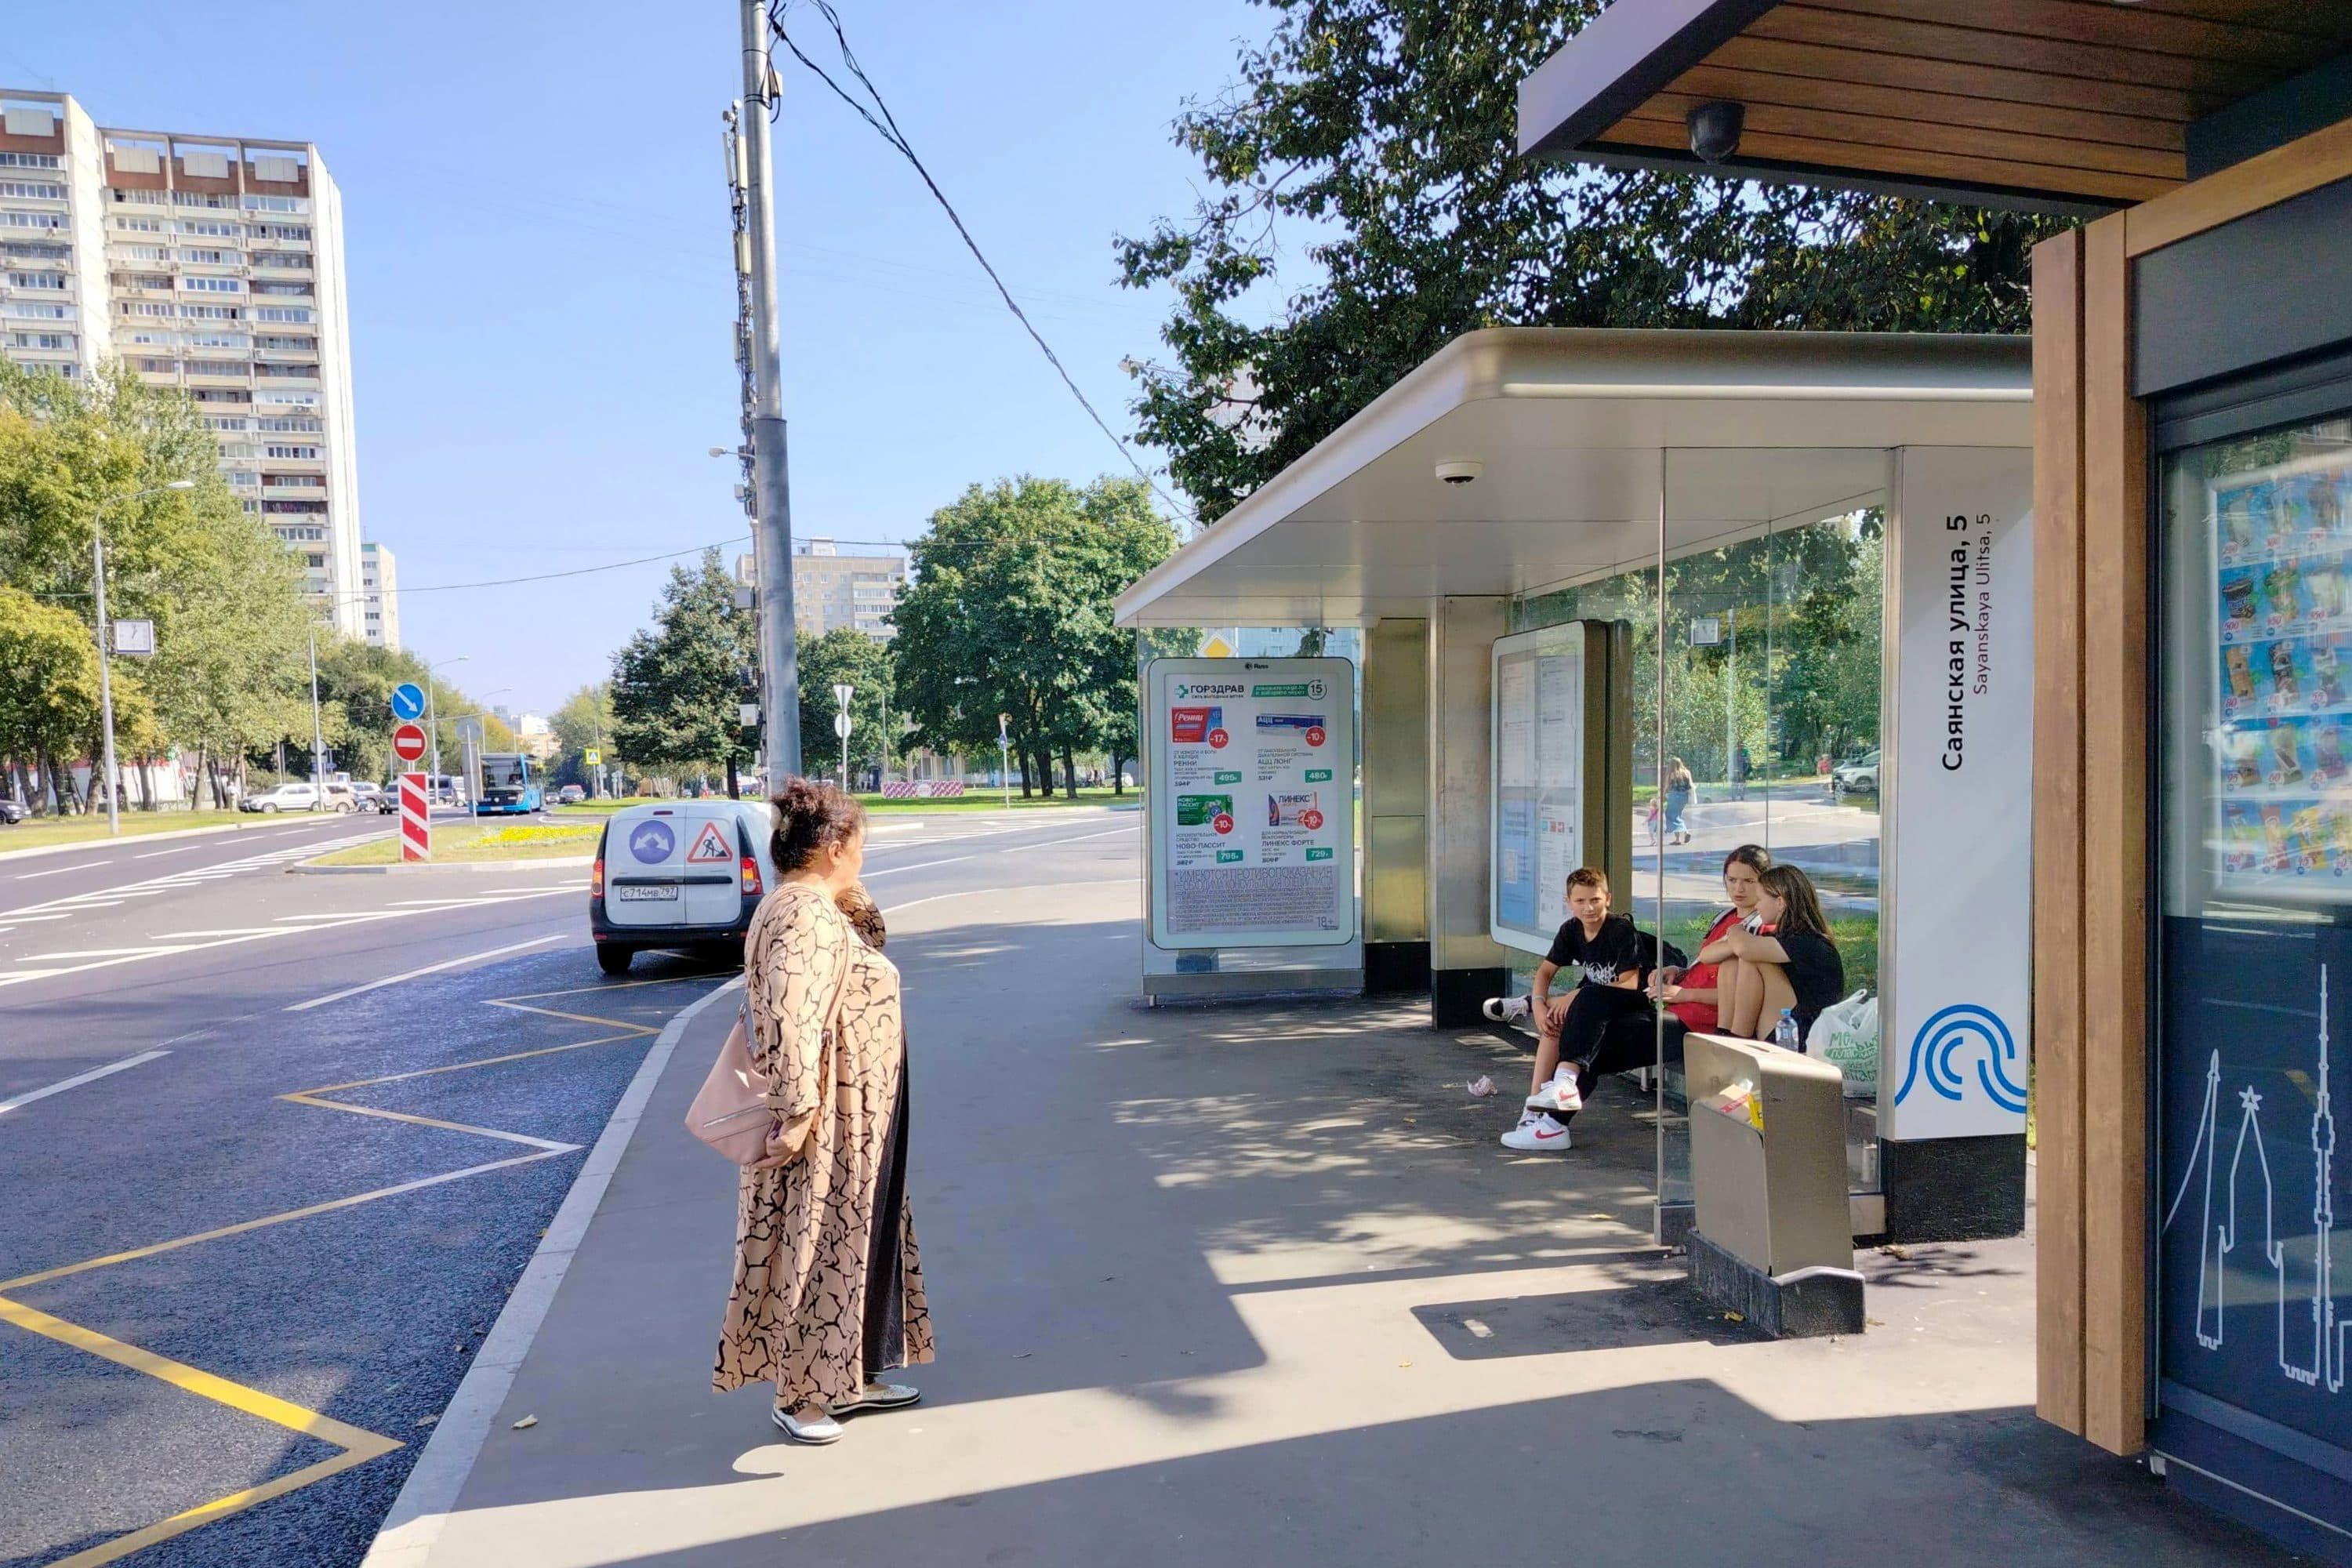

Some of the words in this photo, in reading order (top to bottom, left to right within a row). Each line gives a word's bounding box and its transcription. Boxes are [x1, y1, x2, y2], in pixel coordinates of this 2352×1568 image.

[1946, 515, 1967, 531] 5
[1976, 514, 1991, 524] 5
[1976, 530, 1992, 585] Ulitsa,
[1950, 541, 1970, 632] улица,
[1973, 592, 1993, 694] Sayanskaya
[1190, 684, 1245, 695] ГОРЗДРАВ
[1311, 684, 1323, 694] 15
[1942, 641, 1965, 771] Саянская
[1317, 916, 1334, 927] 18+
